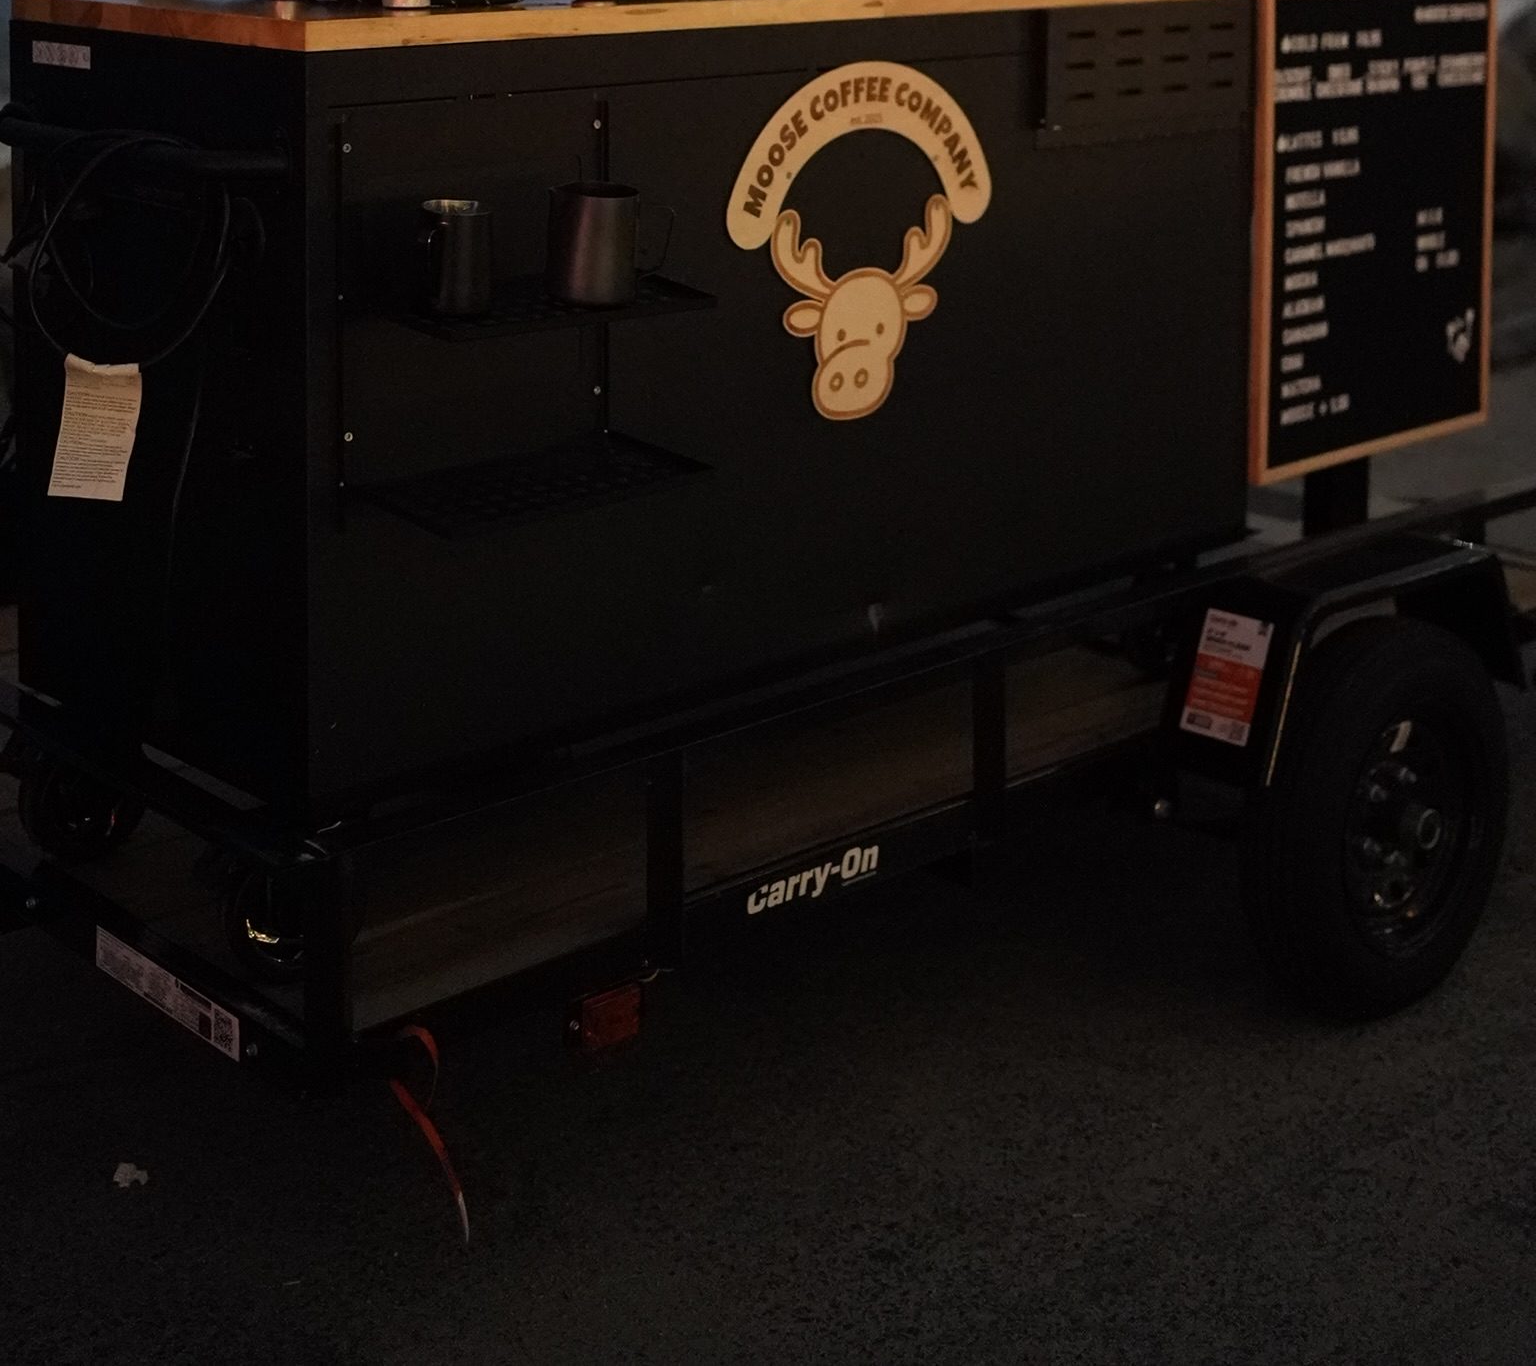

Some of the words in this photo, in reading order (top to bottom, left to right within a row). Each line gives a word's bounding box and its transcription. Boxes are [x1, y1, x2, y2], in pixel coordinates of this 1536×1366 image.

[743, 110, 809, 218] MOOSE
[810, 76, 892, 122] COFFEE
[894, 82, 979, 191] COMPANY
[746, 844, 880, 915] Carry-On
